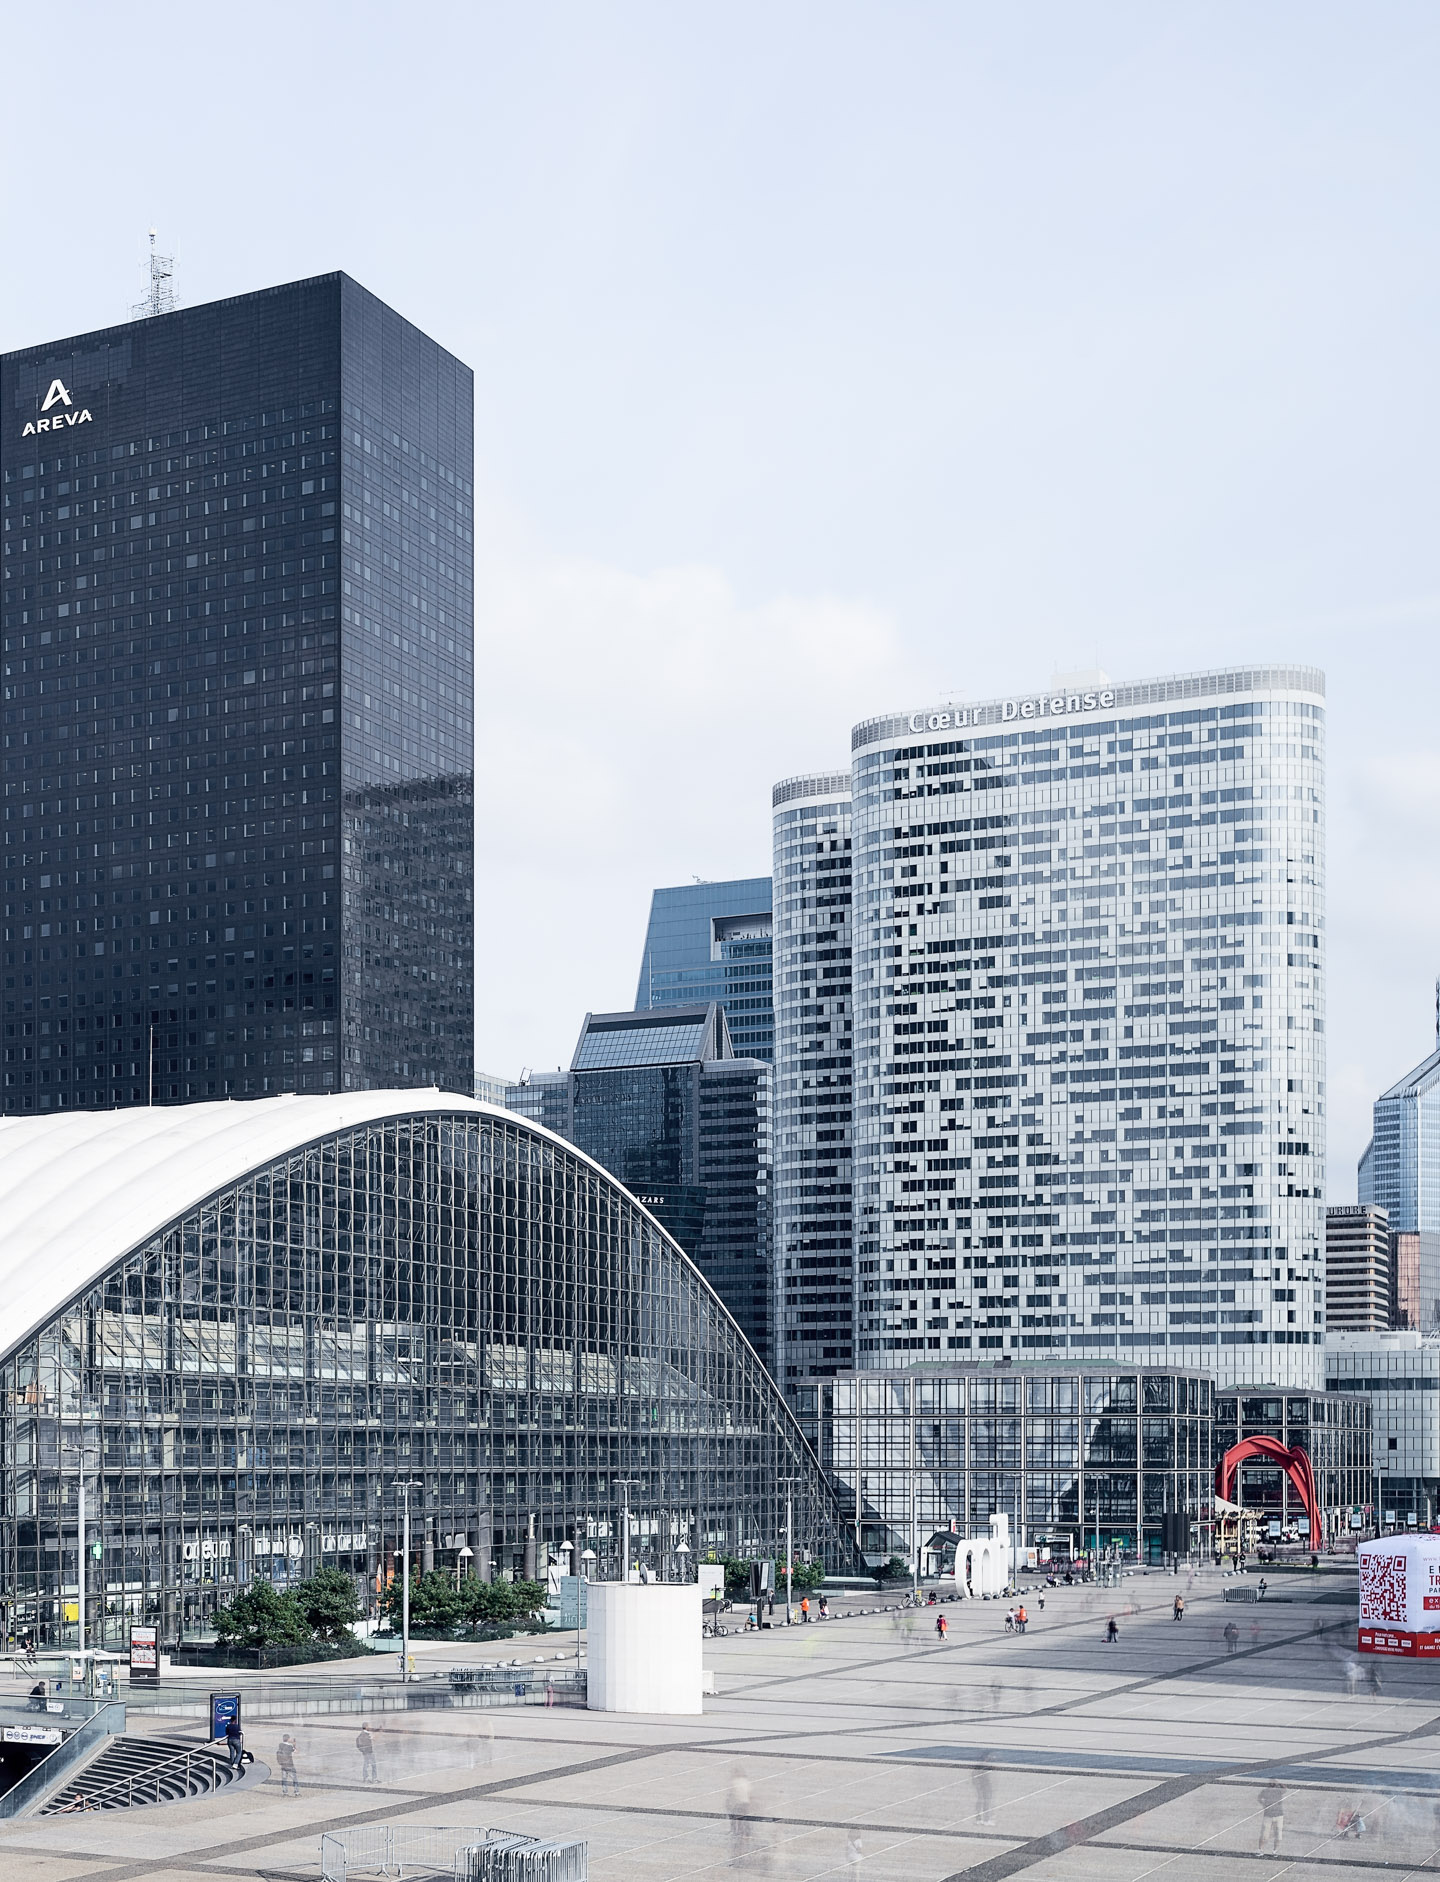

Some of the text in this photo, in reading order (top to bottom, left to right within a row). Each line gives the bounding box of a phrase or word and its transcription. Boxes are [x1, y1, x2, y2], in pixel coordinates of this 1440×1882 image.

[22, 409, 92, 436] AREVA
[909, 689, 1115, 732] Cœur Défense
